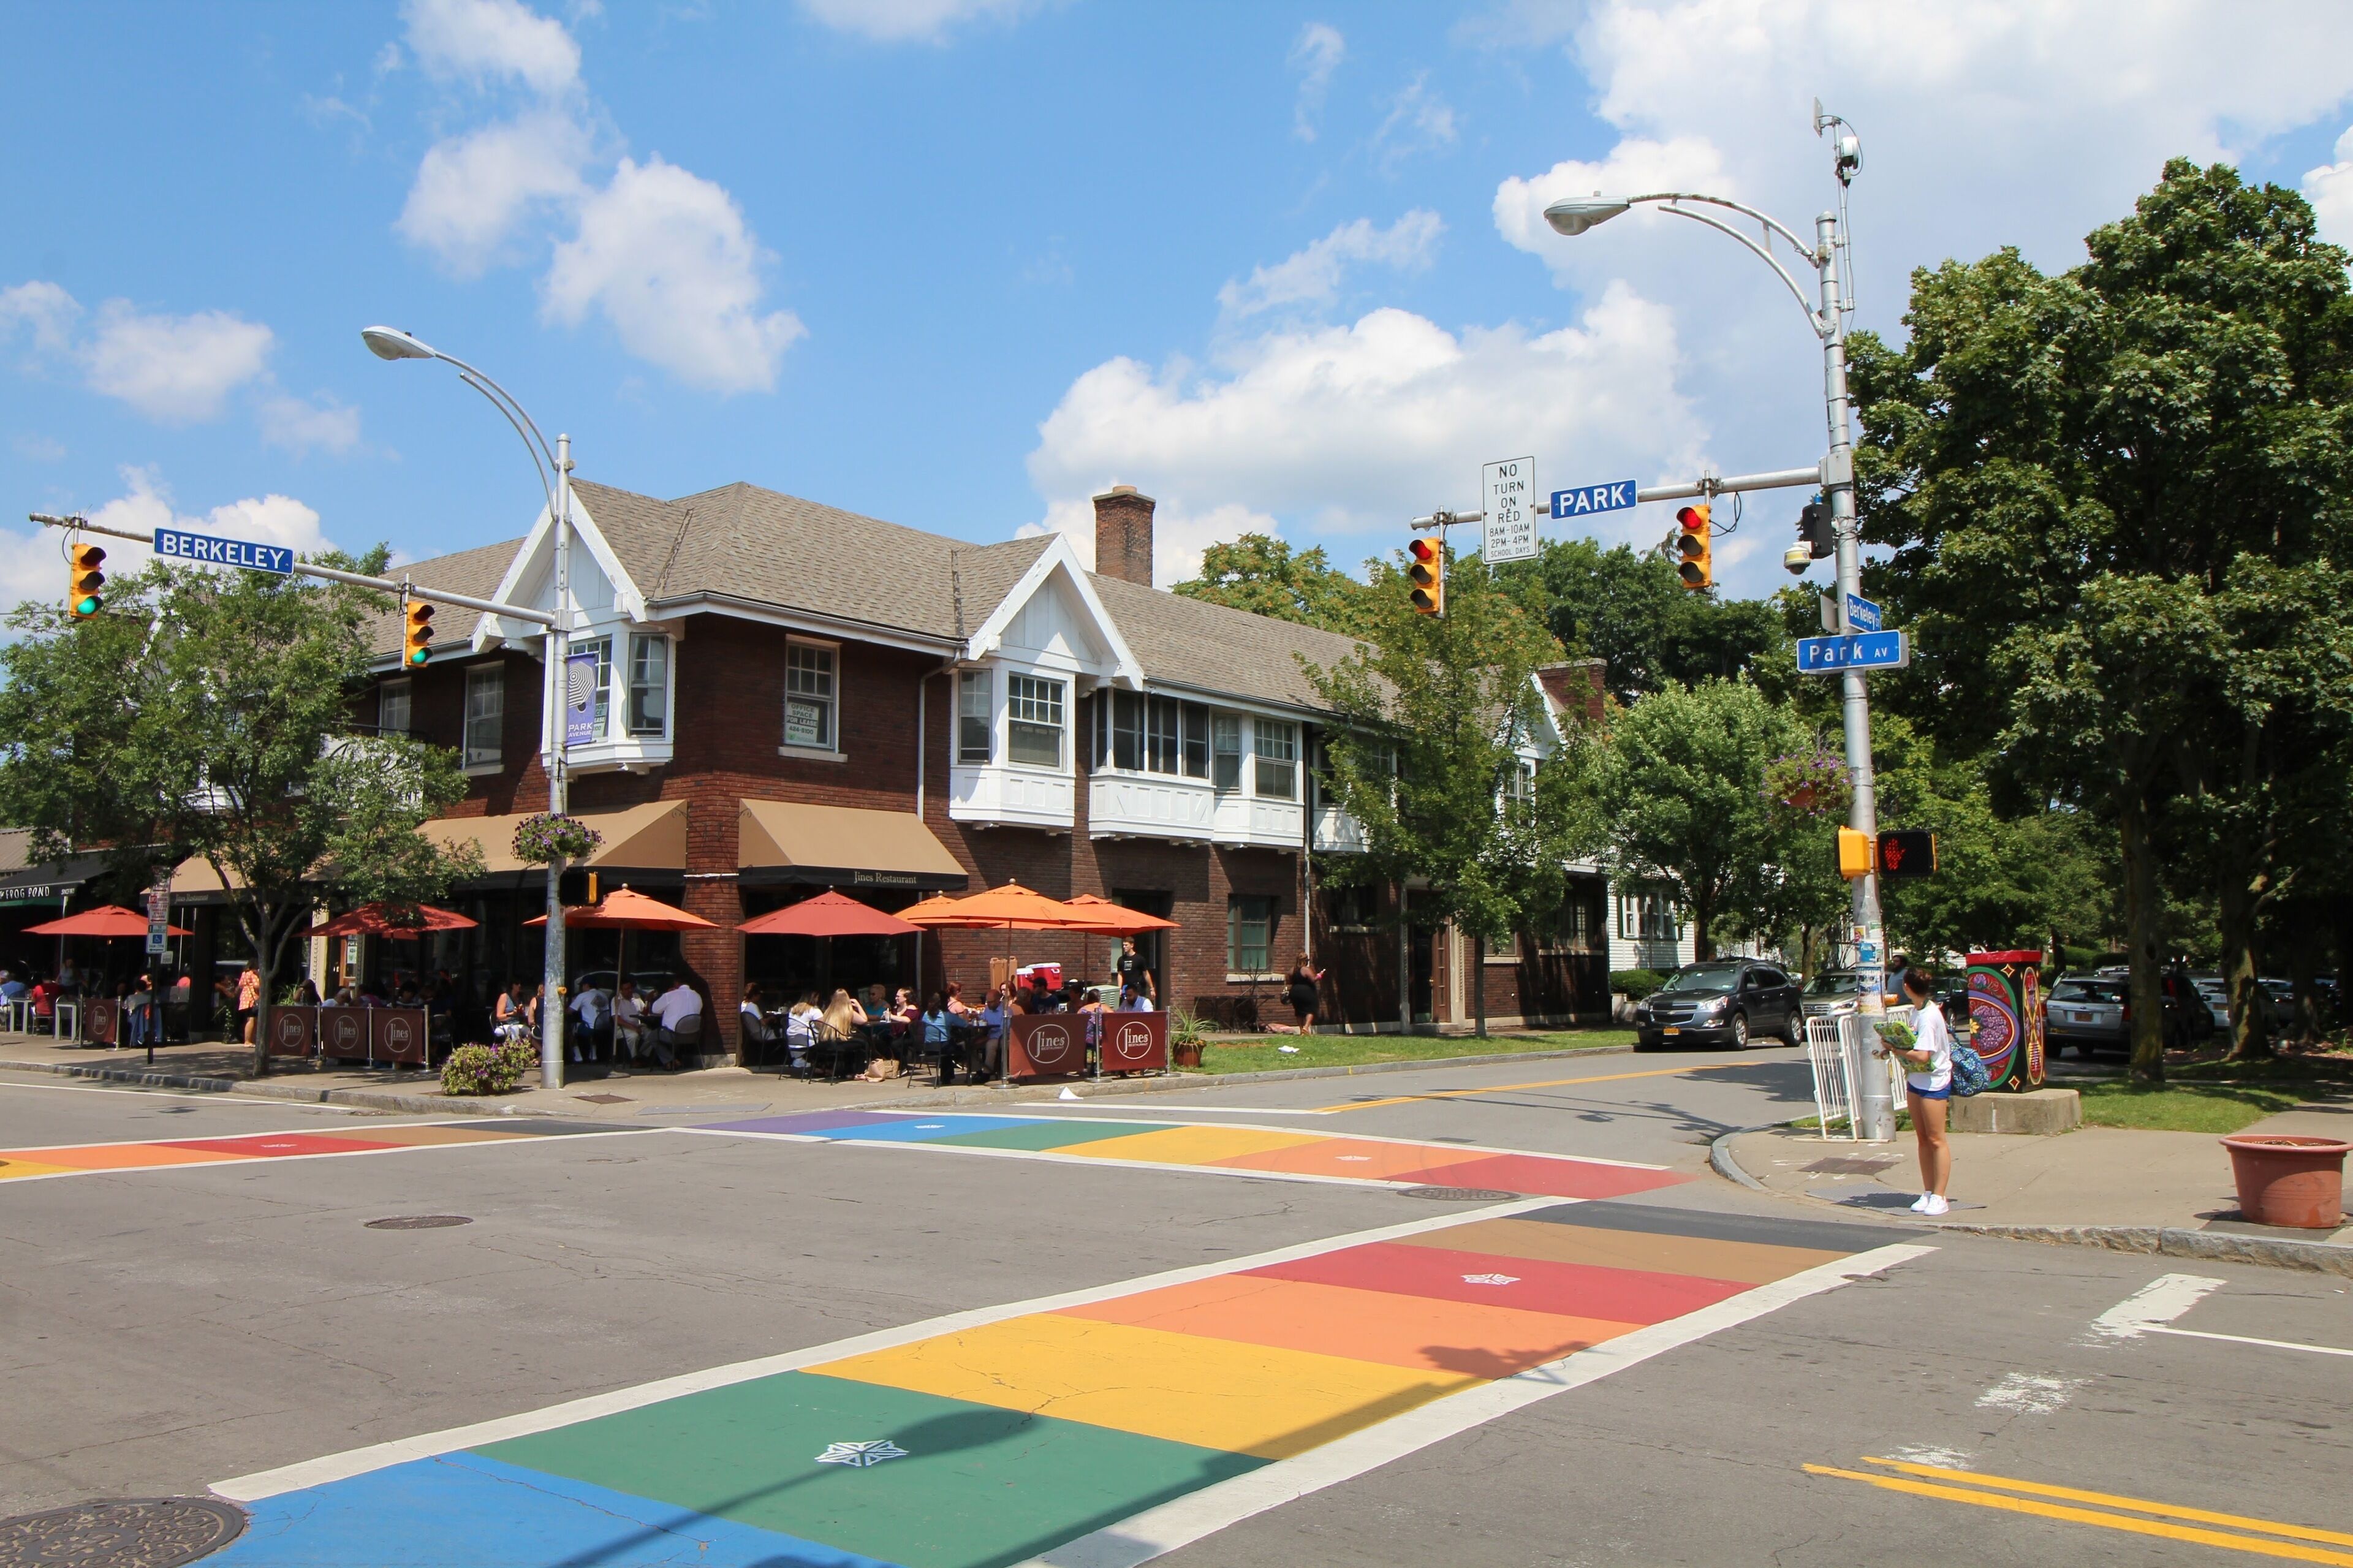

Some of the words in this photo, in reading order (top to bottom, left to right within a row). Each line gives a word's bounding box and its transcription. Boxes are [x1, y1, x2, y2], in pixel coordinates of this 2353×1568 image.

[1499, 464, 1517, 479] NO
[1493, 480, 1525, 495] TURN
[1501, 496, 1517, 508] ON
[1559, 483, 1627, 516] PARK
[1498, 511, 1520, 524] RED
[162, 532, 285, 569] BERKELEY
[1490, 548, 1513, 558] SCHOOL
[1515, 547, 1530, 555] DAYS
[1848, 598, 1876, 631] Berkeley
[1809, 642, 1863, 664] Park
[1874, 647, 1888, 658] AV
[791, 703, 814, 713] OFFICE
[792, 710, 813, 719] SPACE
[568, 722, 593, 732] PARK
[854, 871, 873, 884] Jines
[876, 873, 917, 884] Restaurant
[6, 888, 25, 900] FROG
[28, 886, 50, 897] POND
[282, 1019, 301, 1041] Jines
[338, 1021, 356, 1043] Jines
[389, 1023, 409, 1047] Jines
[1034, 1031, 1066, 1058] Jines
[1123, 1028, 1149, 1054] Jines
